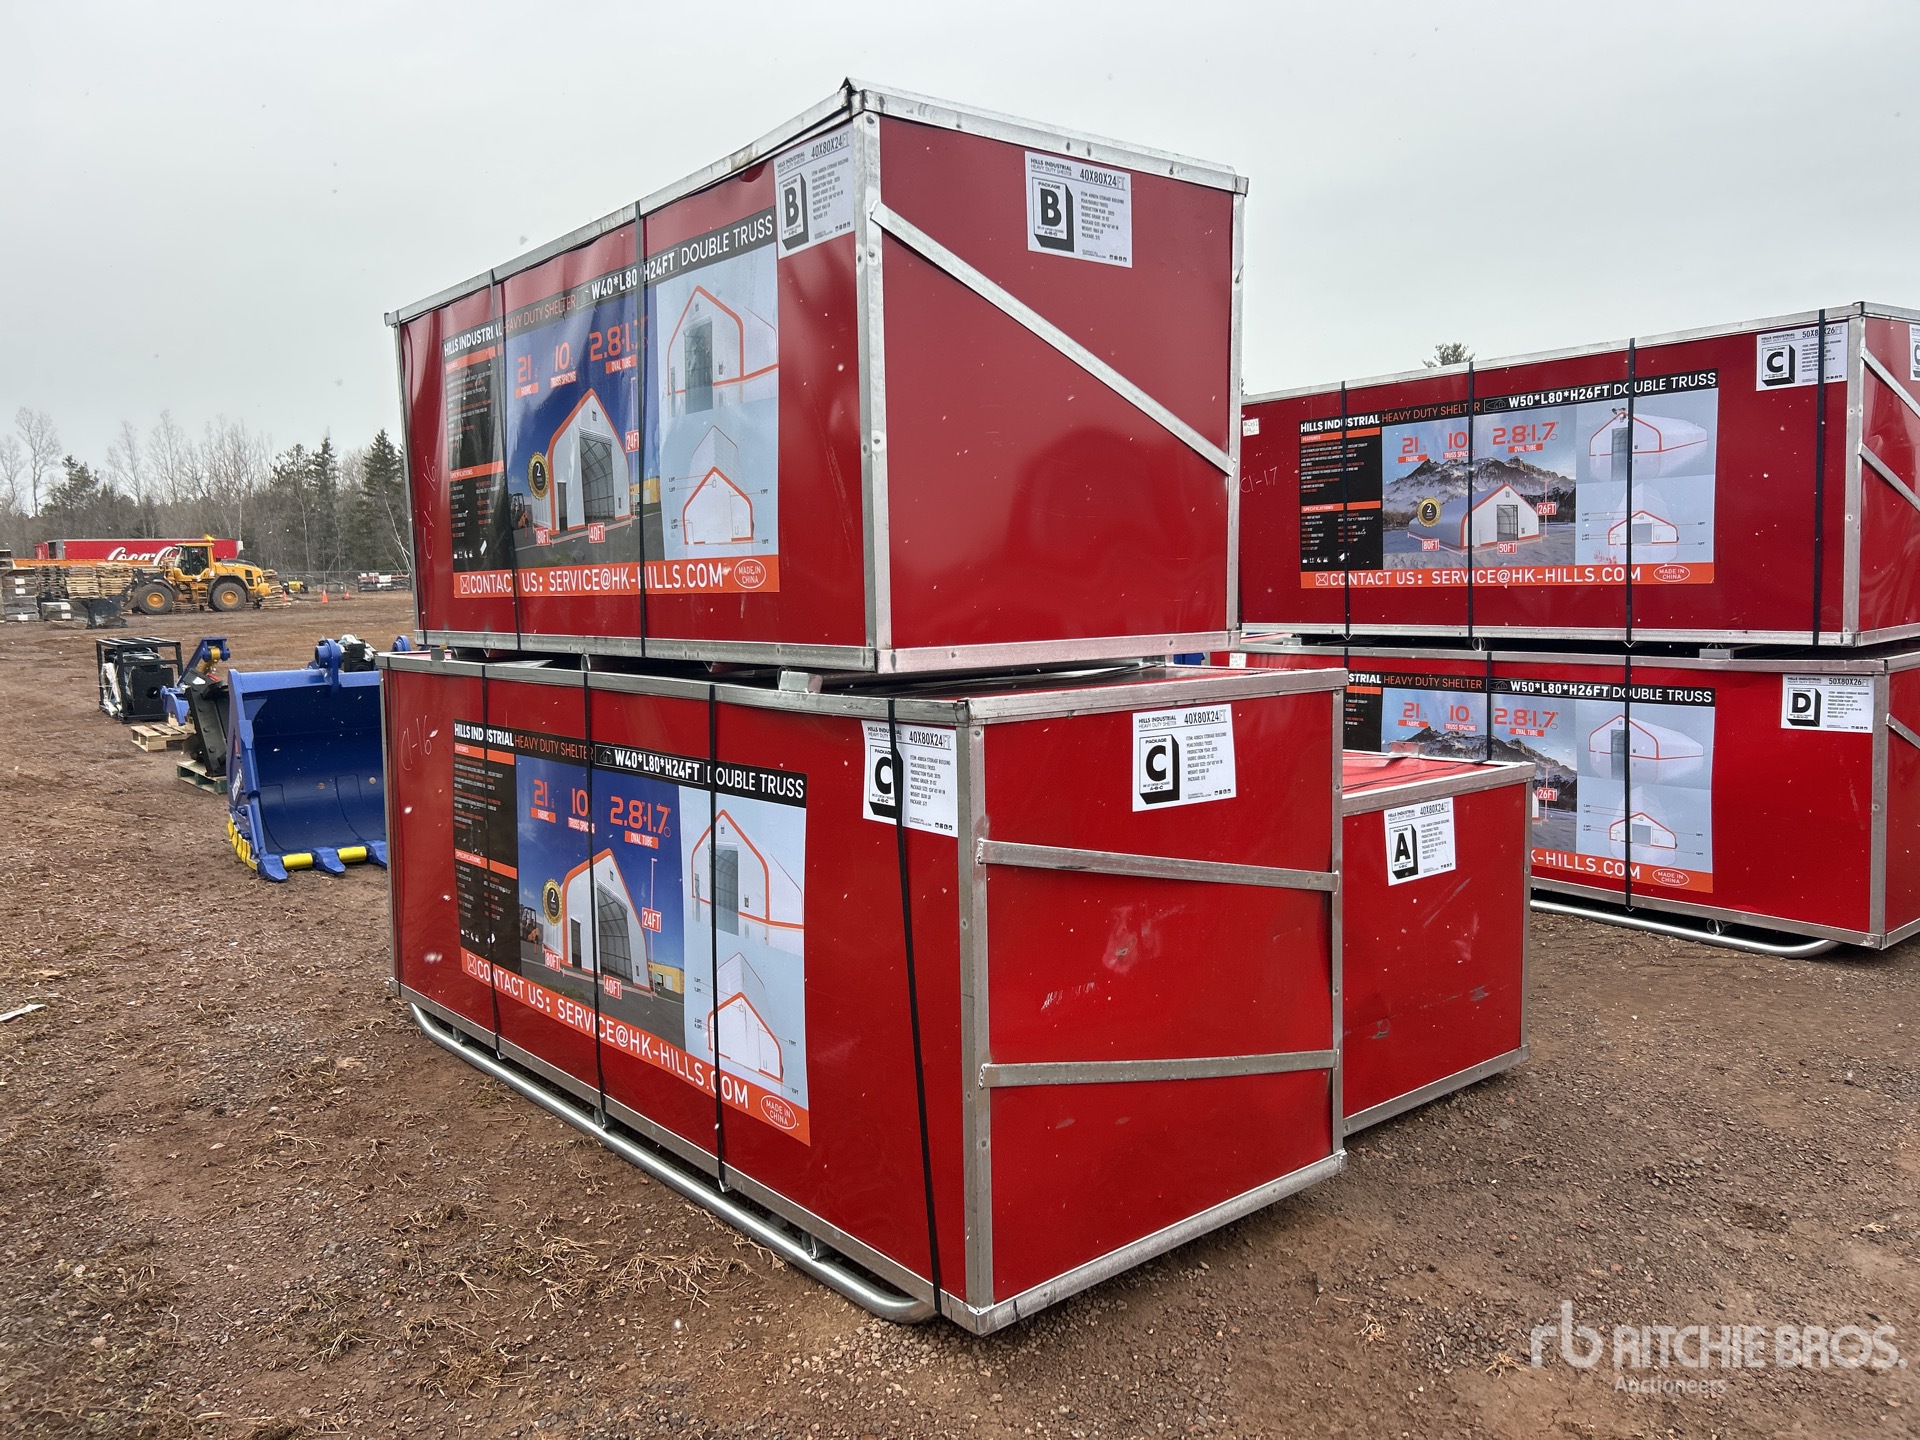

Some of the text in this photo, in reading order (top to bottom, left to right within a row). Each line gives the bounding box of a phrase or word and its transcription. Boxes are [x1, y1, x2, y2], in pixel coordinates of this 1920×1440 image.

[1038, 182, 1060, 190] PACKAGE
[785, 187, 799, 228] B
[1040, 188, 1062, 227] B
[524, 310, 544, 325] DUTY
[681, 232, 730, 266] DOUBLE
[734, 215, 773, 248] TRUSS
[1802, 326, 1843, 338] 50X8X26FT
[516, 354, 532, 383] 21
[554, 342, 570, 372] 10
[1766, 351, 1784, 373] C
[1301, 421, 1323, 433] HILLS
[1381, 411, 1411, 423] HEAVY
[1413, 408, 1438, 419] DUTY
[1440, 402, 1480, 416] SHELTR
[1613, 379, 1666, 397] DOUBLE
[1670, 372, 1716, 389] TRUSS
[1402, 436, 1419, 454] 21
[1448, 431, 1468, 449] 10
[536, 462, 541, 476] 2
[1427, 504, 1432, 513] 2
[1538, 505, 1555, 514] 26FT
[589, 524, 604, 541] 40FT
[1423, 541, 1438, 550] 80FT
[107, 546, 178, 566] Coca-C
[738, 565, 761, 575] MADE IN
[742, 576, 759, 584] CHINA
[1329, 572, 1392, 586] CONTACT
[1396, 571, 1422, 584] US:
[522, 571, 543, 592] US:
[1348, 673, 1382, 684] STRIAL
[1384, 676, 1412, 685] HEAVY
[1415, 676, 1439, 687] DUTY
[1442, 679, 1482, 689] SHELTER
[1612, 686, 1662, 701] DOUBLE
[1667, 689, 1712, 703] TRUSS
[1403, 702, 1420, 718] 21
[1450, 705, 1470, 722] 10
[1792, 692, 1811, 713] D
[1151, 715, 1176, 723] INDUSTRIAL
[1184, 709, 1227, 725] 40X80X24FT
[455, 723, 470, 739] HILLS
[471, 725, 514, 747] INDSTRIAL
[514, 734, 539, 750] HEAVY
[540, 739, 558, 754] DUTY
[760, 773, 804, 799] TRUSS
[1146, 745, 1166, 782] C
[875, 756, 892, 794] C
[533, 779, 548, 807] 21
[571, 788, 588, 817] 10
[1538, 790, 1556, 799] 26FT
[1394, 832, 1411, 862] A
[1531, 849, 1640, 879] K-HILLS.COM
[551, 890, 556, 903] 2
[643, 910, 660, 930] 24FT
[477, 960, 524, 998] CONTACT
[527, 984, 550, 1012] US:
[604, 977, 622, 996] 40FT
[766, 1100, 791, 1118] MADE IN
[769, 1111, 788, 1126] CHINA
